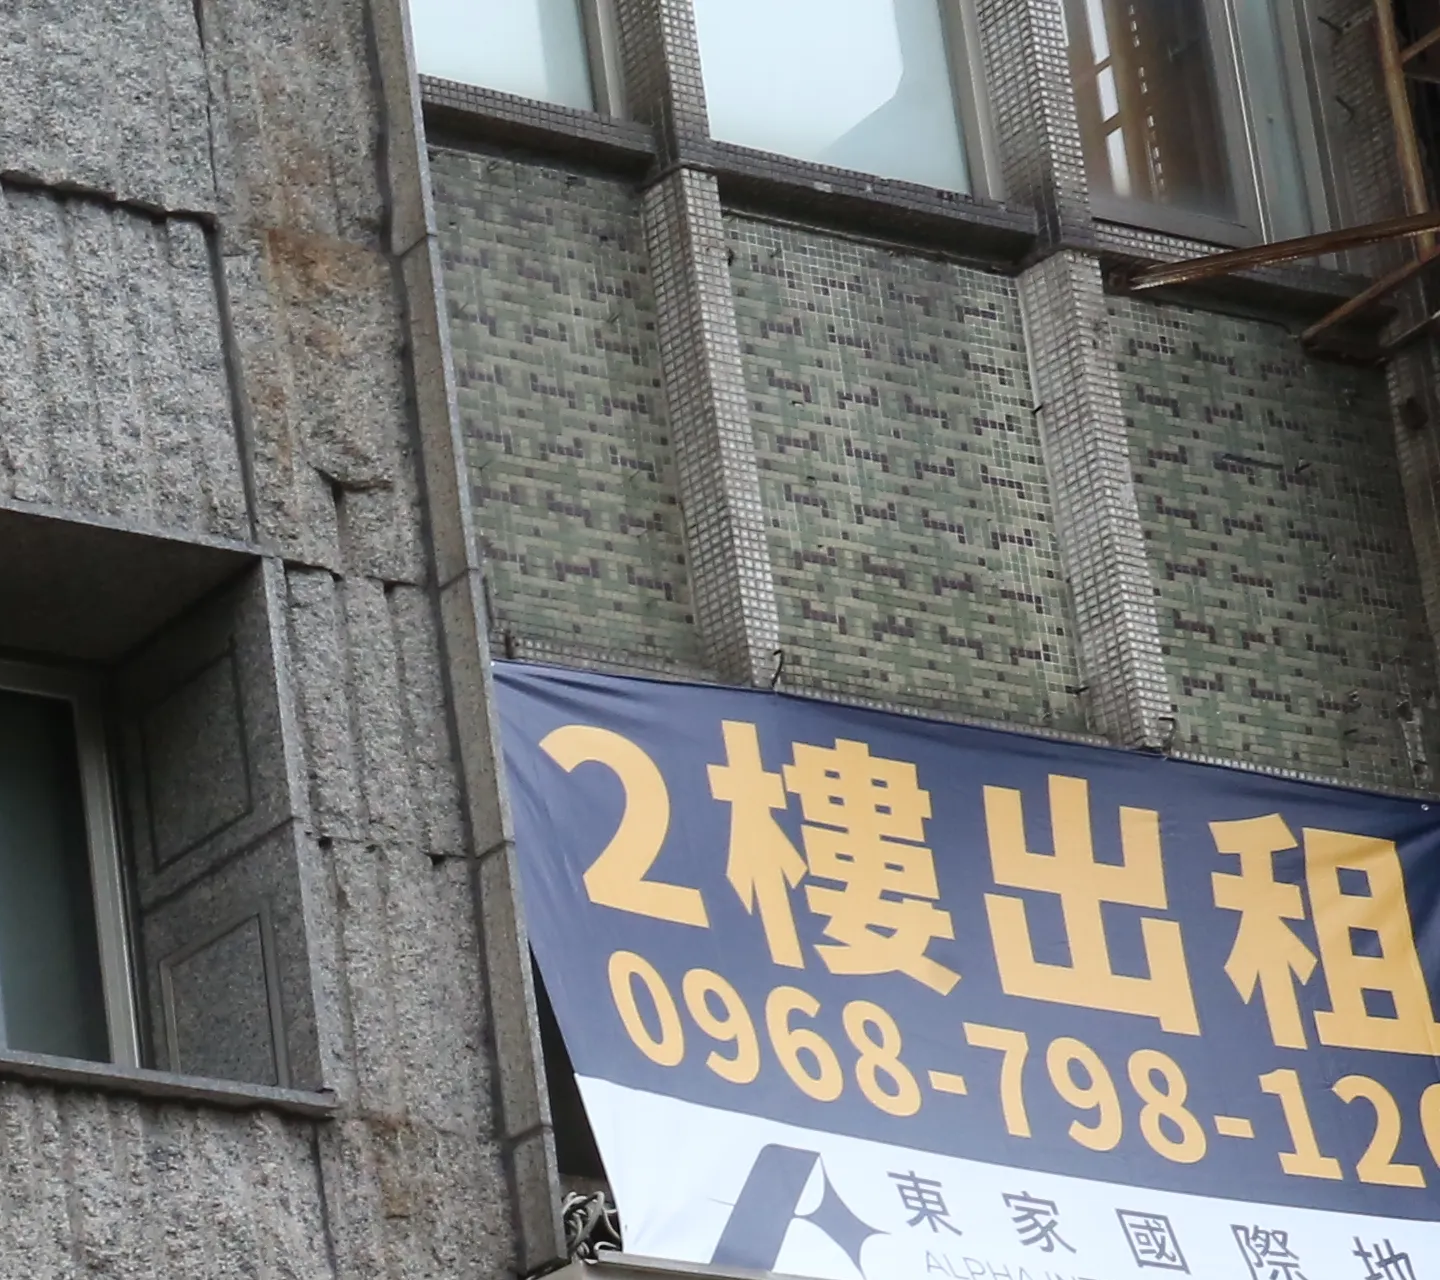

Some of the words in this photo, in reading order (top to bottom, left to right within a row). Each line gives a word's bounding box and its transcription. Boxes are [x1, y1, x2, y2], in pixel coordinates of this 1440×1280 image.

[539, 720, 1440, 1056] 2樓出租
[608, 950, 1440, 1189] 0968-798-12
